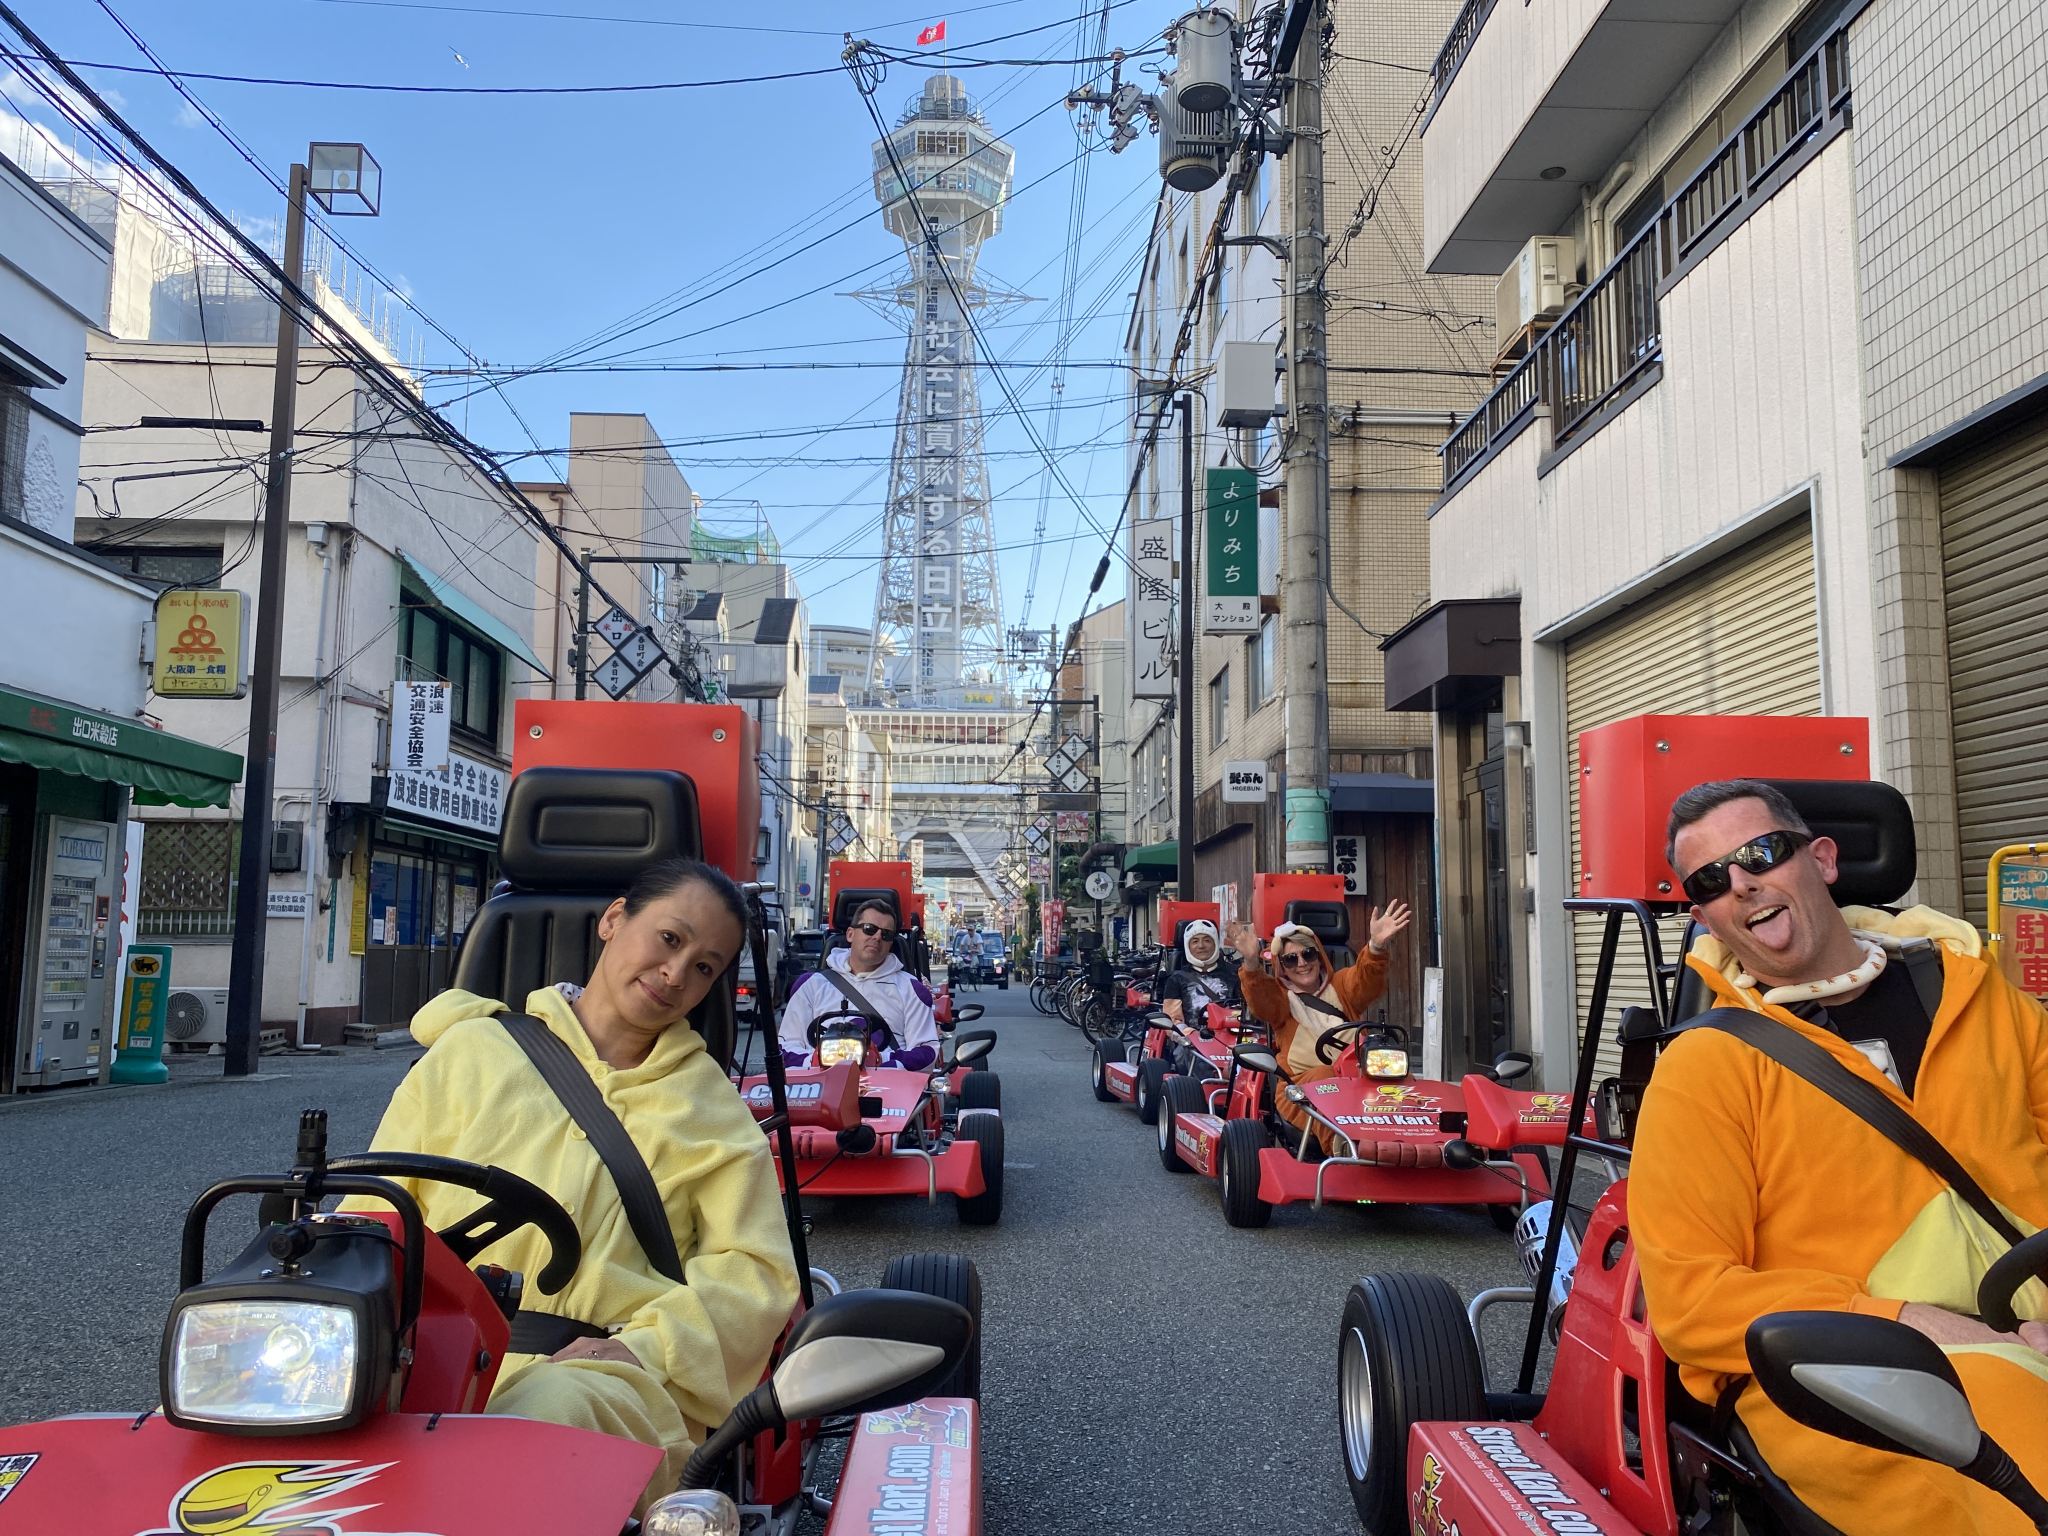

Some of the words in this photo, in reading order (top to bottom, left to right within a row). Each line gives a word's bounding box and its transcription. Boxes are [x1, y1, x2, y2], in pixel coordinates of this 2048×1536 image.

[921, 321, 955, 632] 社会に貢献する日立
[1222, 481, 1242, 584] よりみち
[1137, 536, 1170, 681] 盛隆ビル
[1211, 615, 1254, 624] マンション
[166, 664, 227, 675] 大阪第一食糧
[428, 684, 445, 715] 浪速
[72, 717, 118, 747] 出口米穀店
[407, 684, 427, 768] 交通安全協会
[393, 772, 498, 828] 浪速自家用自動車協会
[60, 838, 104, 860] TOBACCO
[1335, 1115, 1393, 1126] Street
[1393, 1115, 1433, 1126] Kart
[1466, 1426, 1543, 1471] Street
[1503, 1469, 1578, 1506] Kart
